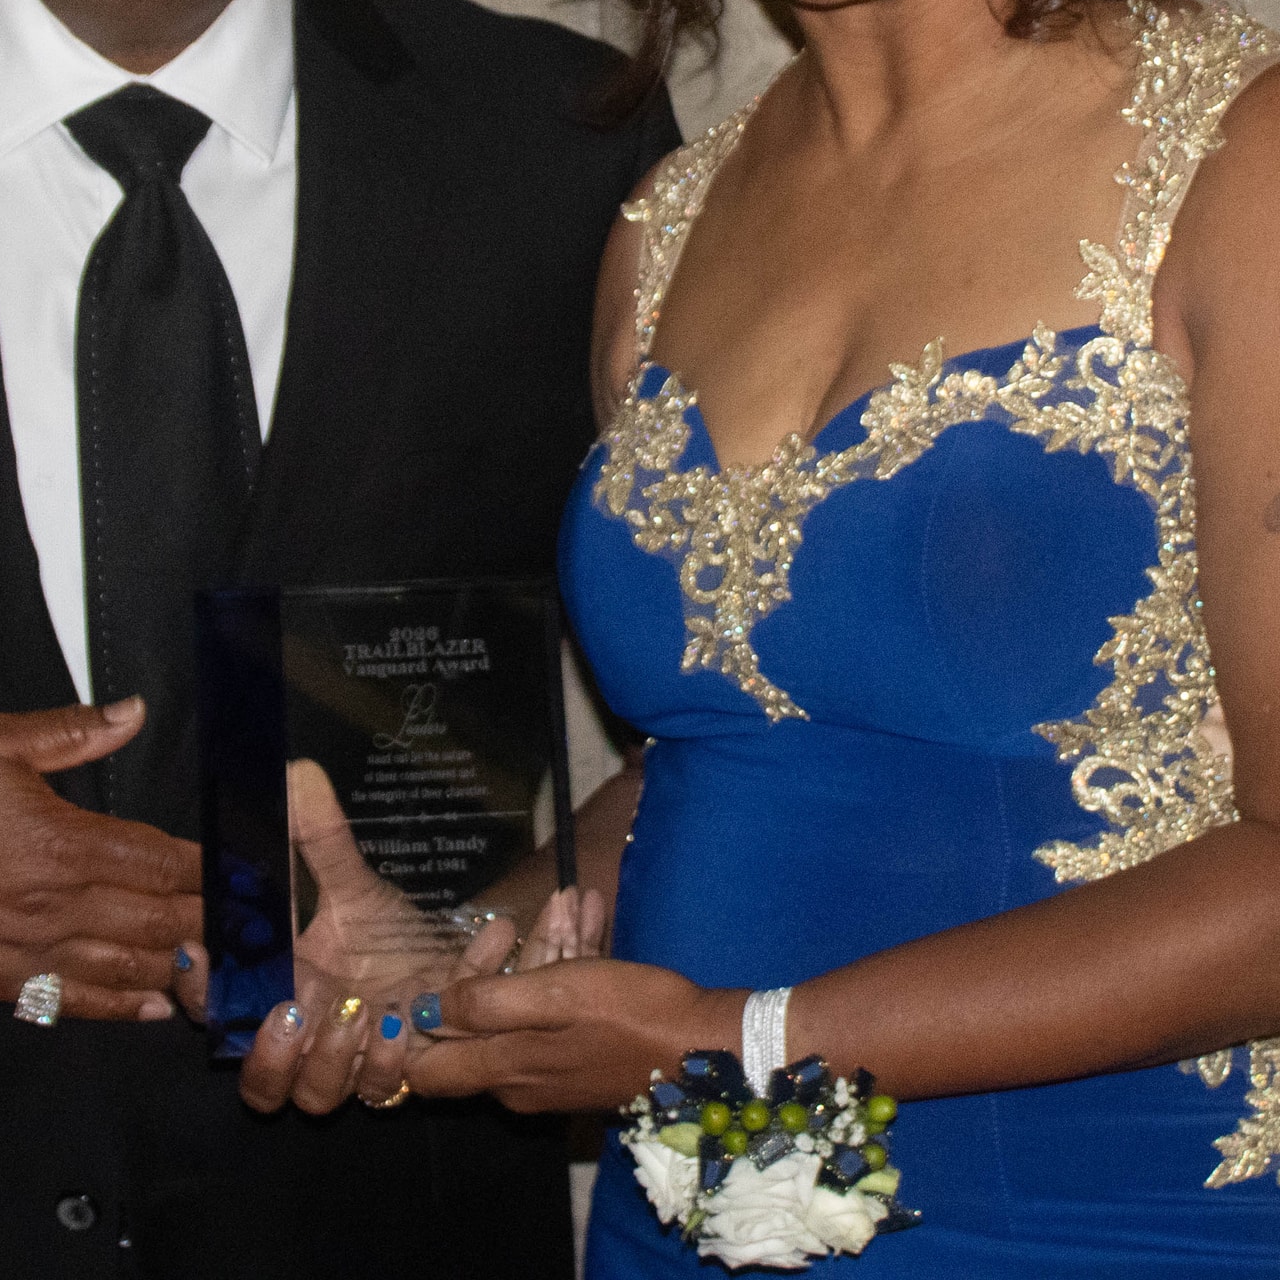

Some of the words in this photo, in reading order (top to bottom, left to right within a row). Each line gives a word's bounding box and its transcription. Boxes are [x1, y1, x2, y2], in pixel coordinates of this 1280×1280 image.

[343, 638, 486, 661] TRAILBLAZER
[342, 659, 428, 678] Vanguard
[432, 654, 490, 672] Award
[358, 838, 430, 855] William
[432, 835, 488, 854] Tandy
[378, 860, 416, 874] Class
[418, 858, 433, 873] of
